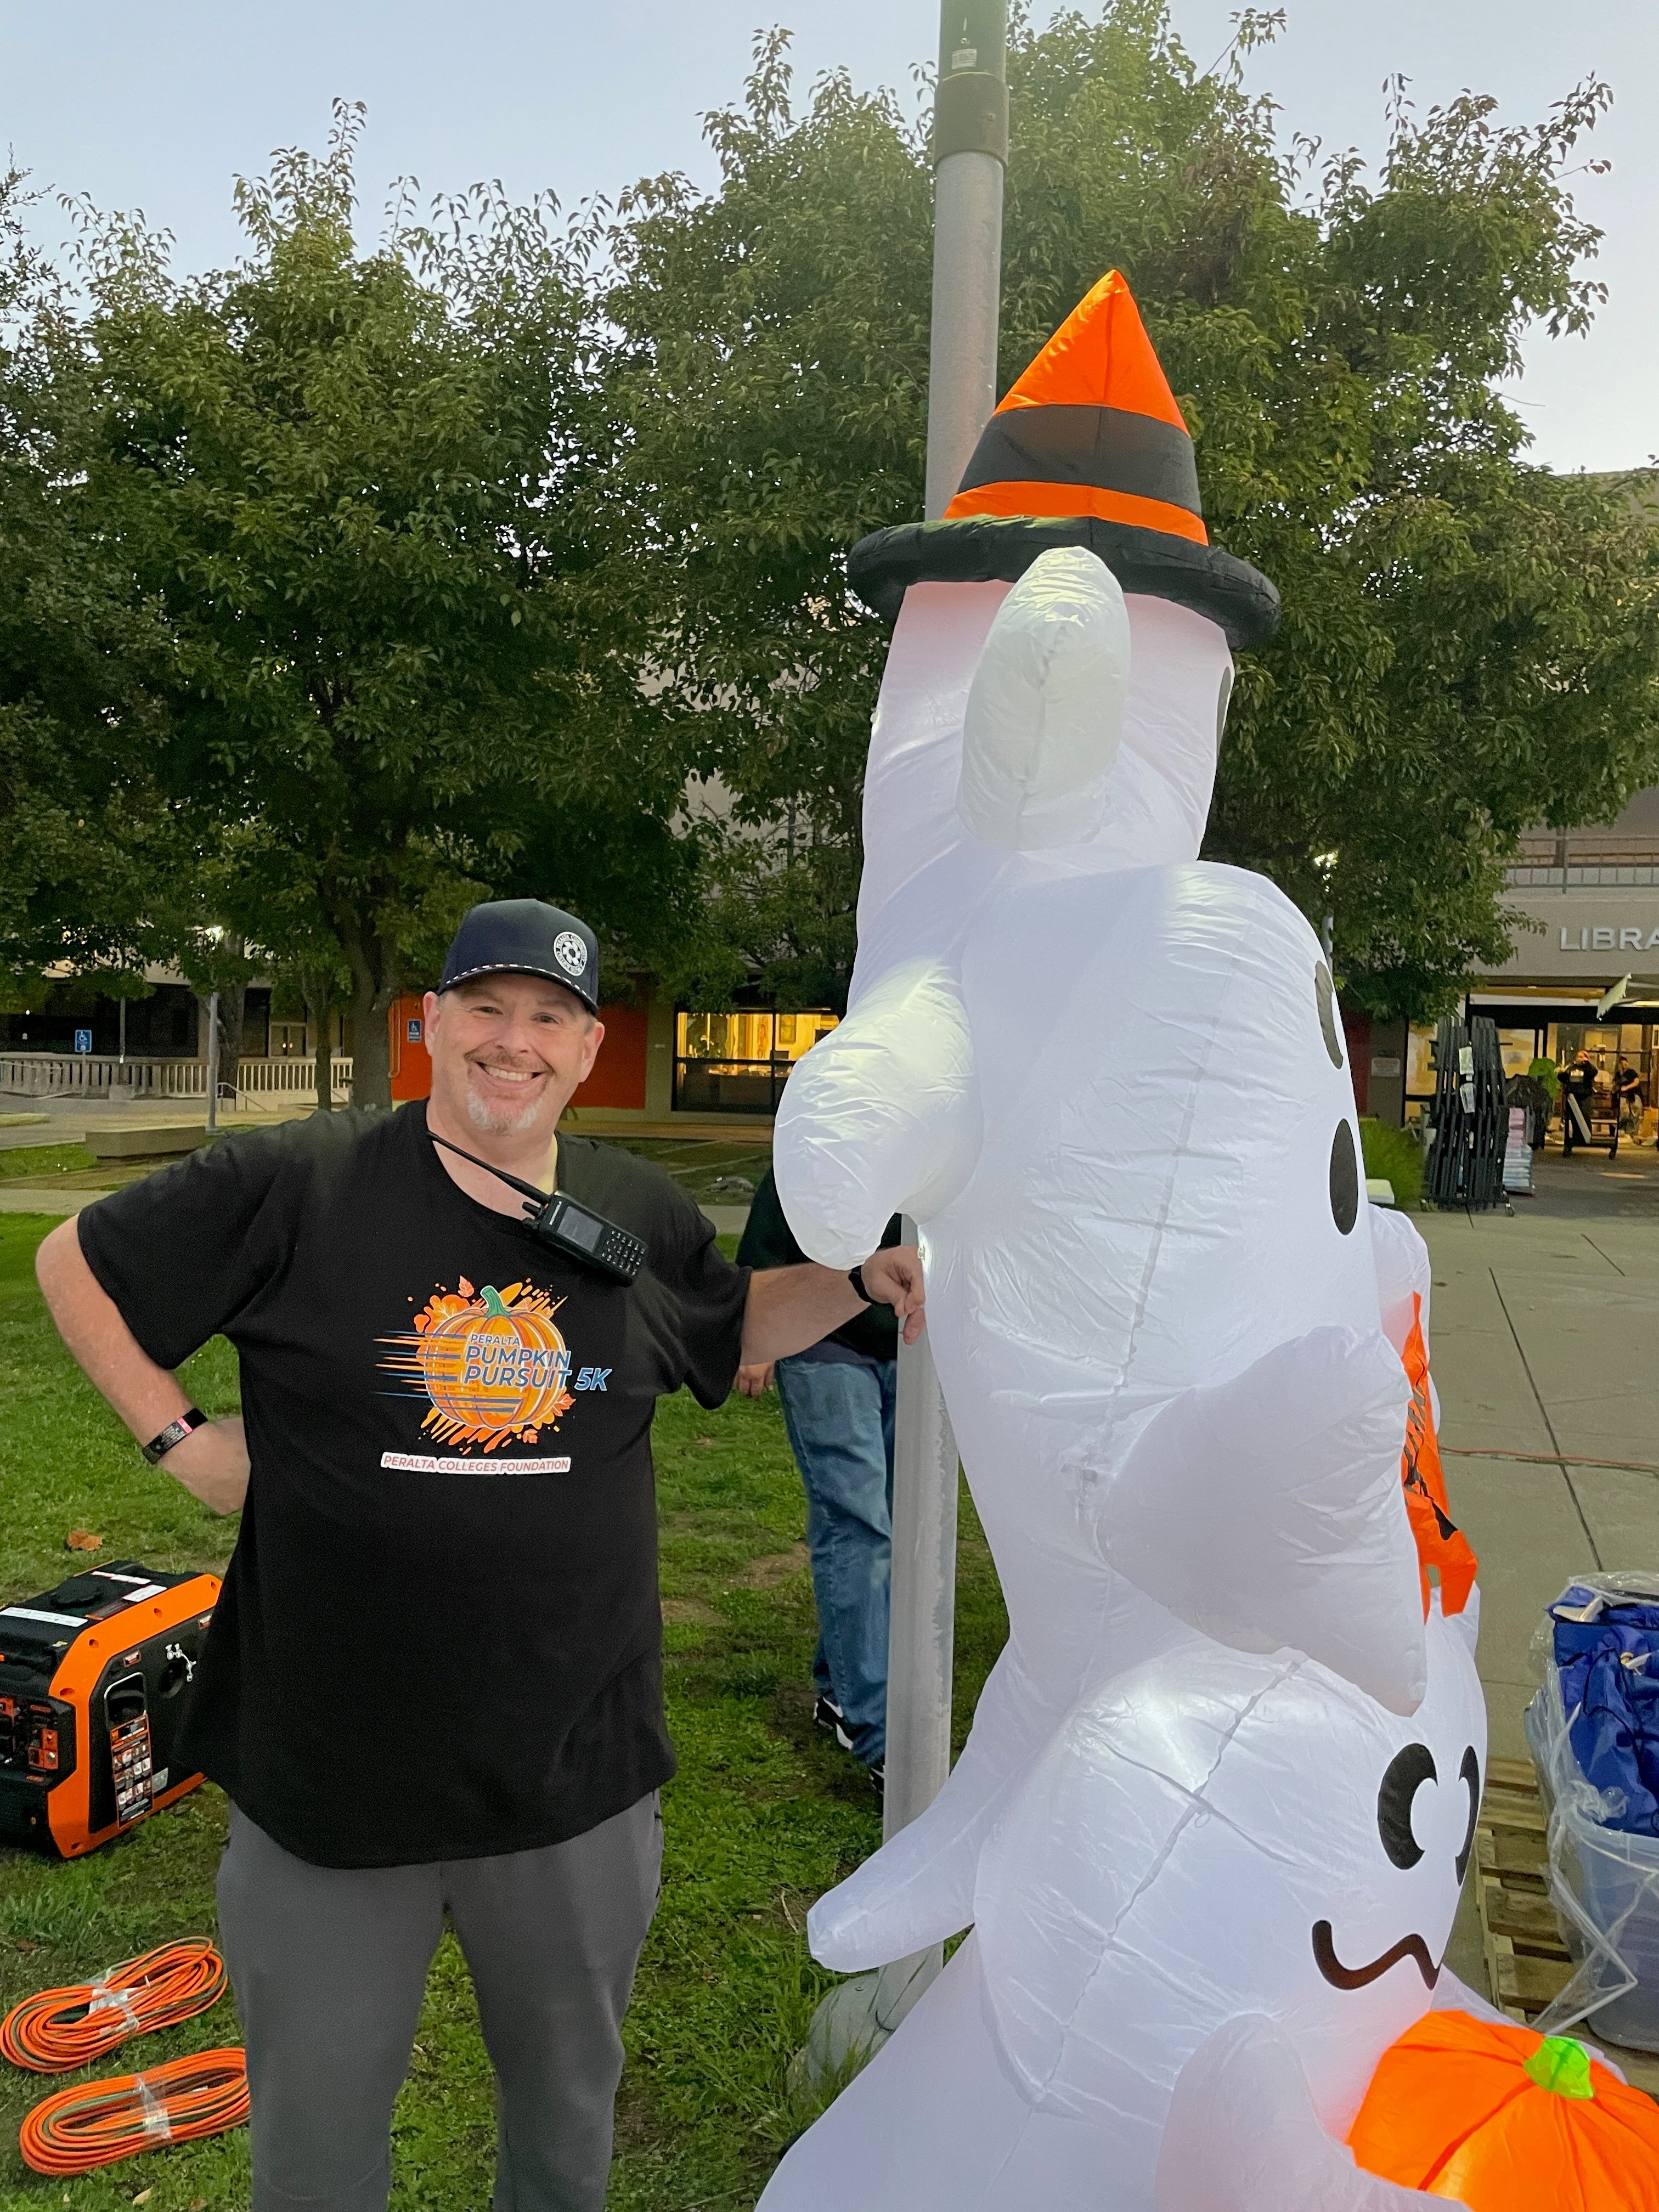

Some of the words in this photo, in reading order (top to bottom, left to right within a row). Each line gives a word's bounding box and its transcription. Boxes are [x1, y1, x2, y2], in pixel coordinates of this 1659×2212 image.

[1560, 926, 1659, 950] LIBRA
[470, 1334, 520, 1346] PERALTA
[465, 1345, 571, 1368] PUMPKIN
[464, 1365, 572, 1389] PURSUIT
[574, 1367, 613, 1391] 5K
[383, 1455, 435, 1470] PERALTA
[438, 1460, 497, 1472] COLLEGES
[500, 1459, 569, 1472] FOUNDATION
